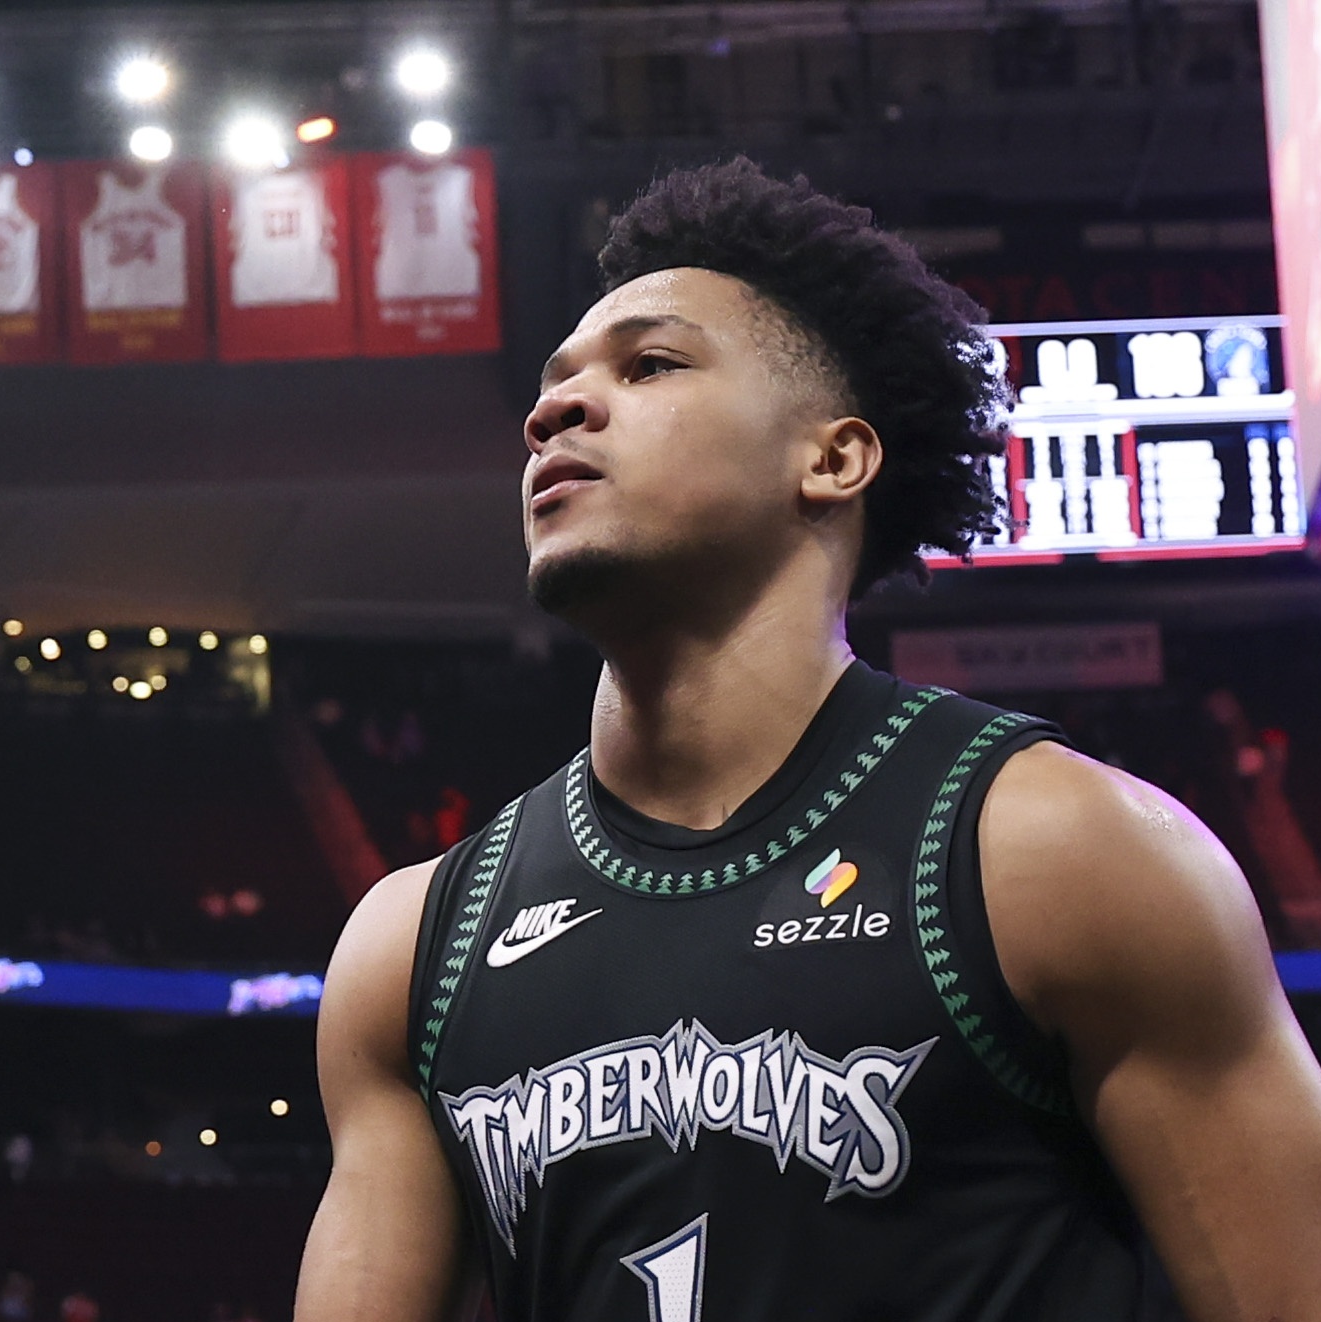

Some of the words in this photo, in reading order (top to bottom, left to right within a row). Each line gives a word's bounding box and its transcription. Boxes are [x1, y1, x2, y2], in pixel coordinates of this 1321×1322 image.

[507, 898, 578, 940] NIKE
[752, 903, 891, 949] sezzle
[437, 1017, 940, 1260] TIMBERWOLVES
